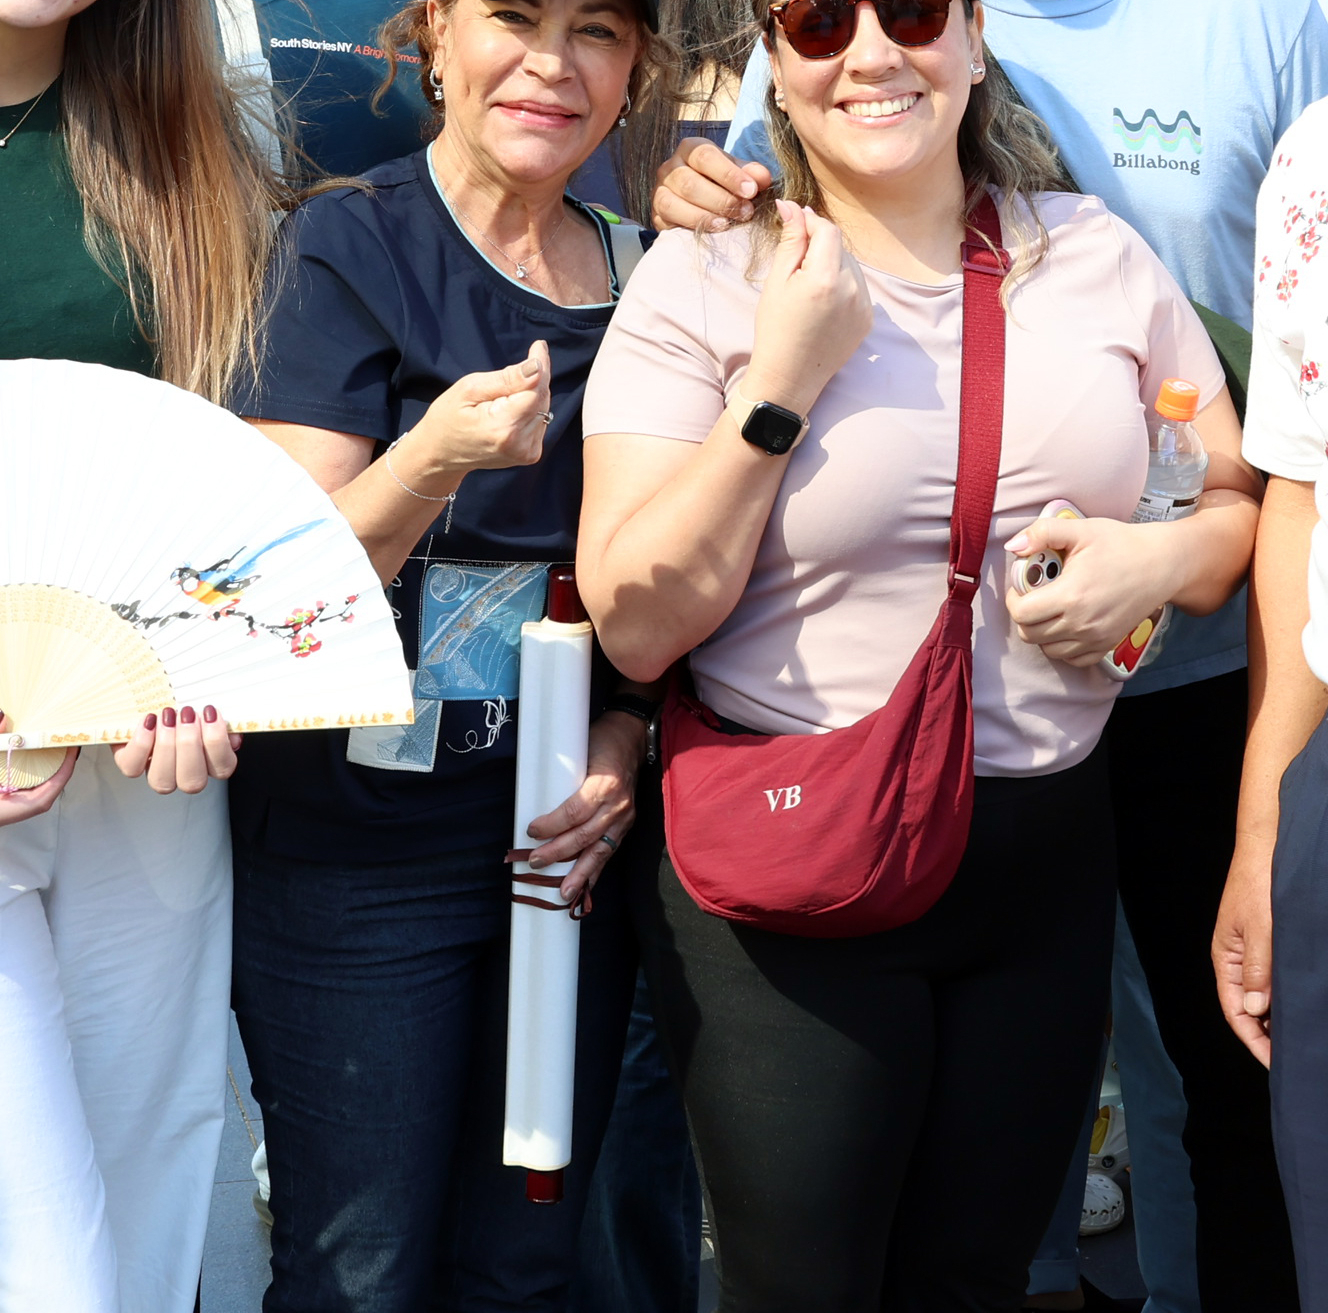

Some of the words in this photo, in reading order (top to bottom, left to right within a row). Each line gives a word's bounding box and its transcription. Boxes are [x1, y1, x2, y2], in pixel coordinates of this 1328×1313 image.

[270, 37, 301, 48] South
[301, 38, 338, 52] Stories
[337, 42, 353, 53] NY
[353, 45, 362, 55] A
[362, 46, 388, 60] Brigh
[1112, 151, 1202, 176] Billabong
[762, 783, 803, 814] VB
